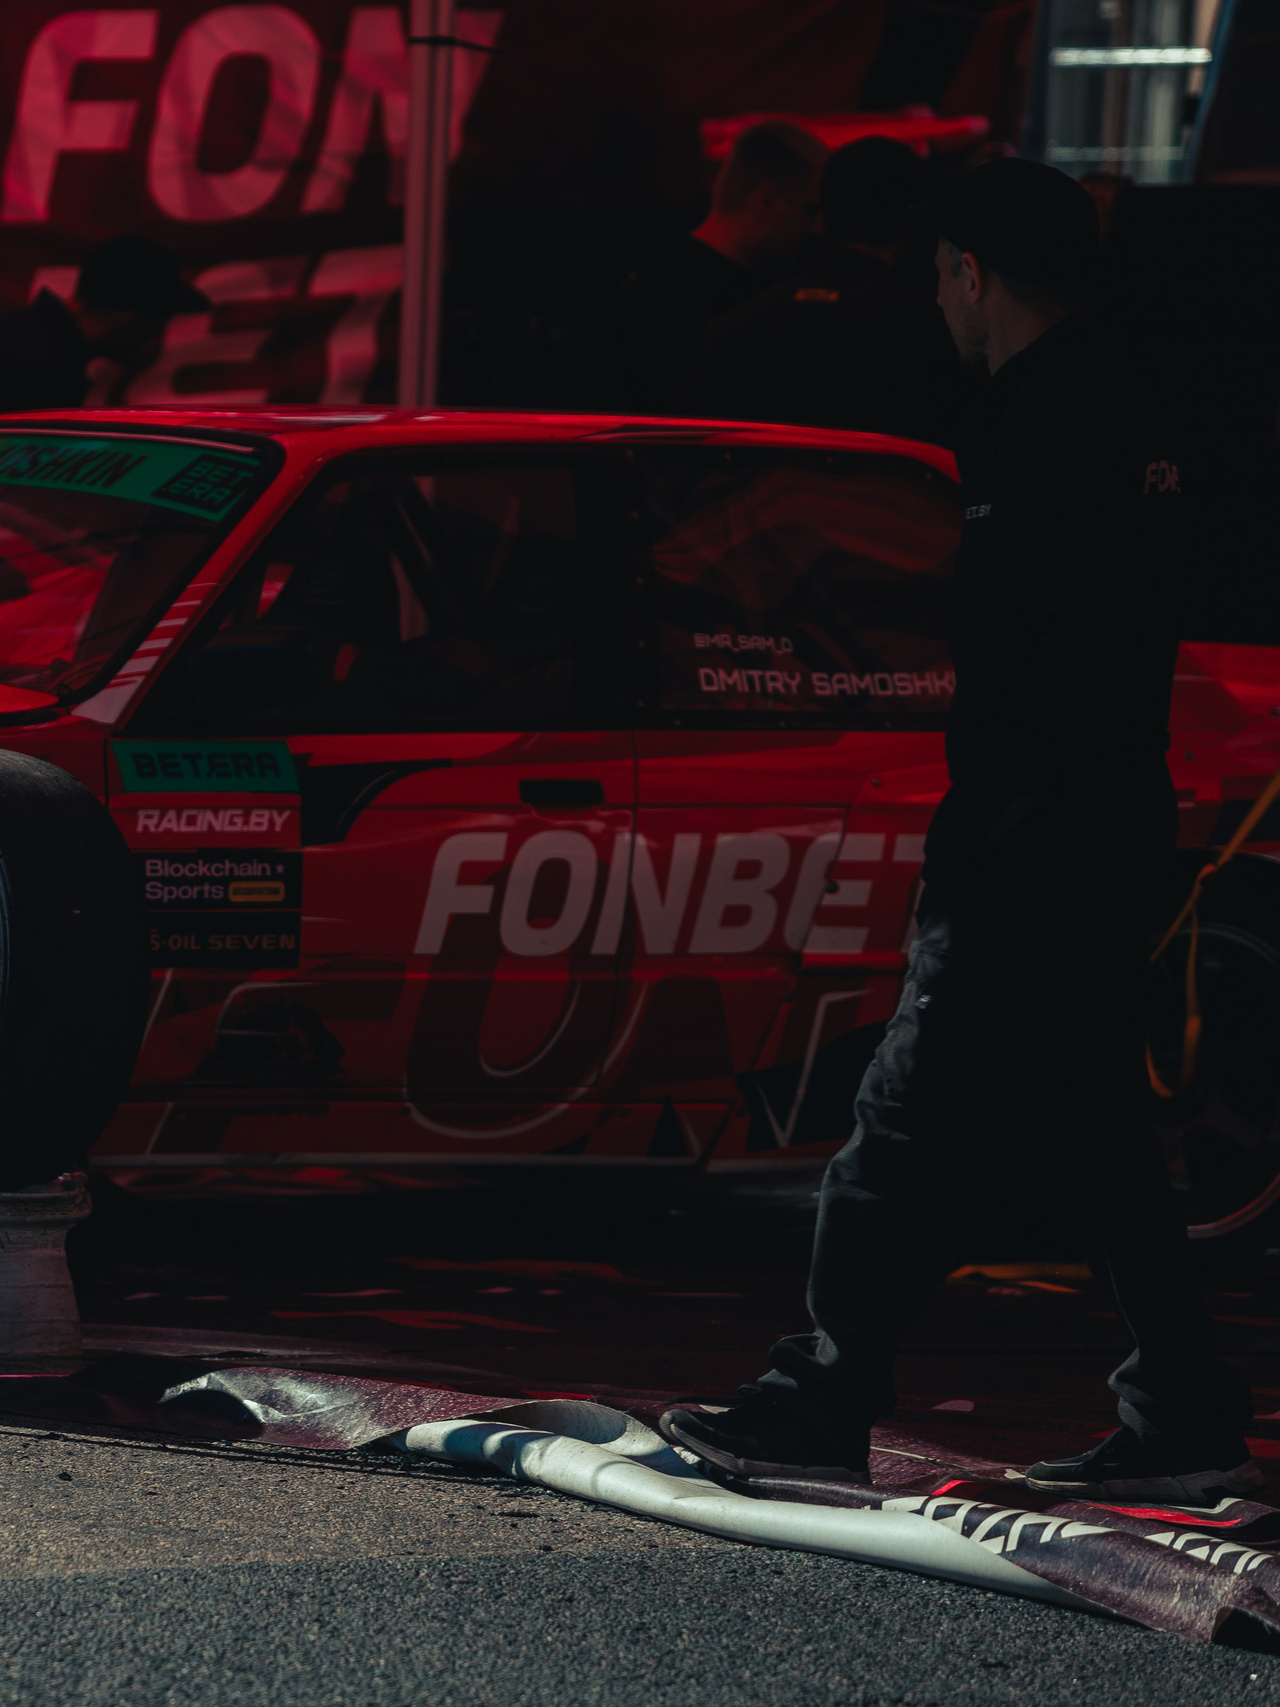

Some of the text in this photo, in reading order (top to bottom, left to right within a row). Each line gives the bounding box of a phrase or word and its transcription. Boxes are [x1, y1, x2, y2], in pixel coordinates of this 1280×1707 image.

[698, 667, 802, 696] DMITRY
[133, 751, 281, 779] BETERA
[136, 808, 292, 833] RACING.BY
[145, 858, 271, 878] Blockchain
[145, 881, 225, 903] Sports
[208, 934, 296, 951] SEVEN
